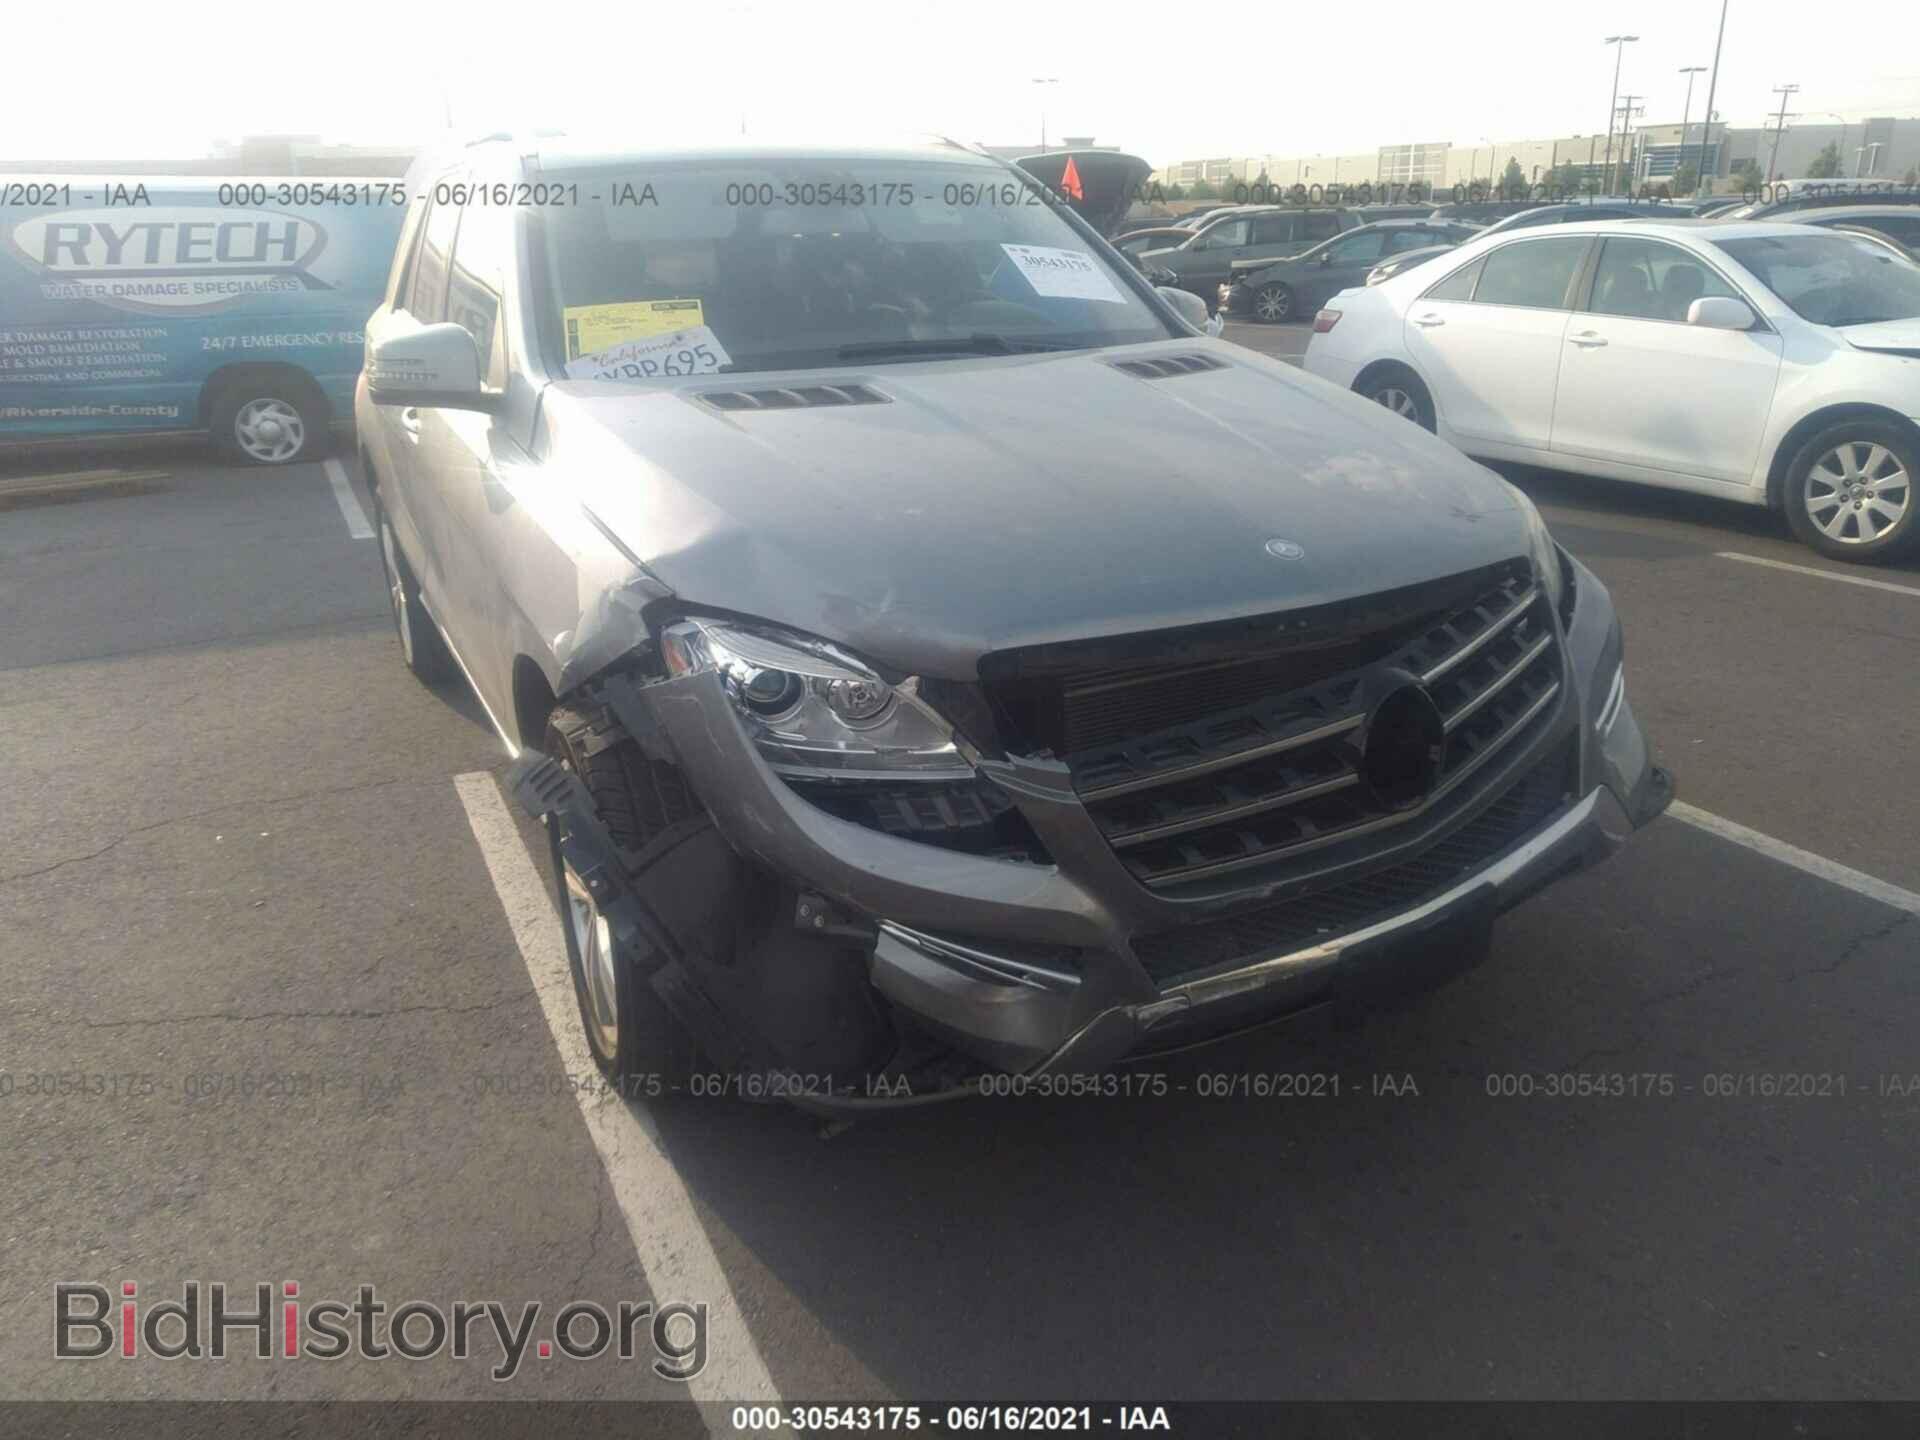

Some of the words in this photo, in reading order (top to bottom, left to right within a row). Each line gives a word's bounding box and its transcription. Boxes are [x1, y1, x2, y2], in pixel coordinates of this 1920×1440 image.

[43, 222, 299, 265] RYTECH
[113, 282, 189, 296] DAMAGE
[194, 279, 297, 295] SPECIALISTS
[201, 335, 236, 350] 24/7
[241, 332, 334, 348] EMERGENCY
